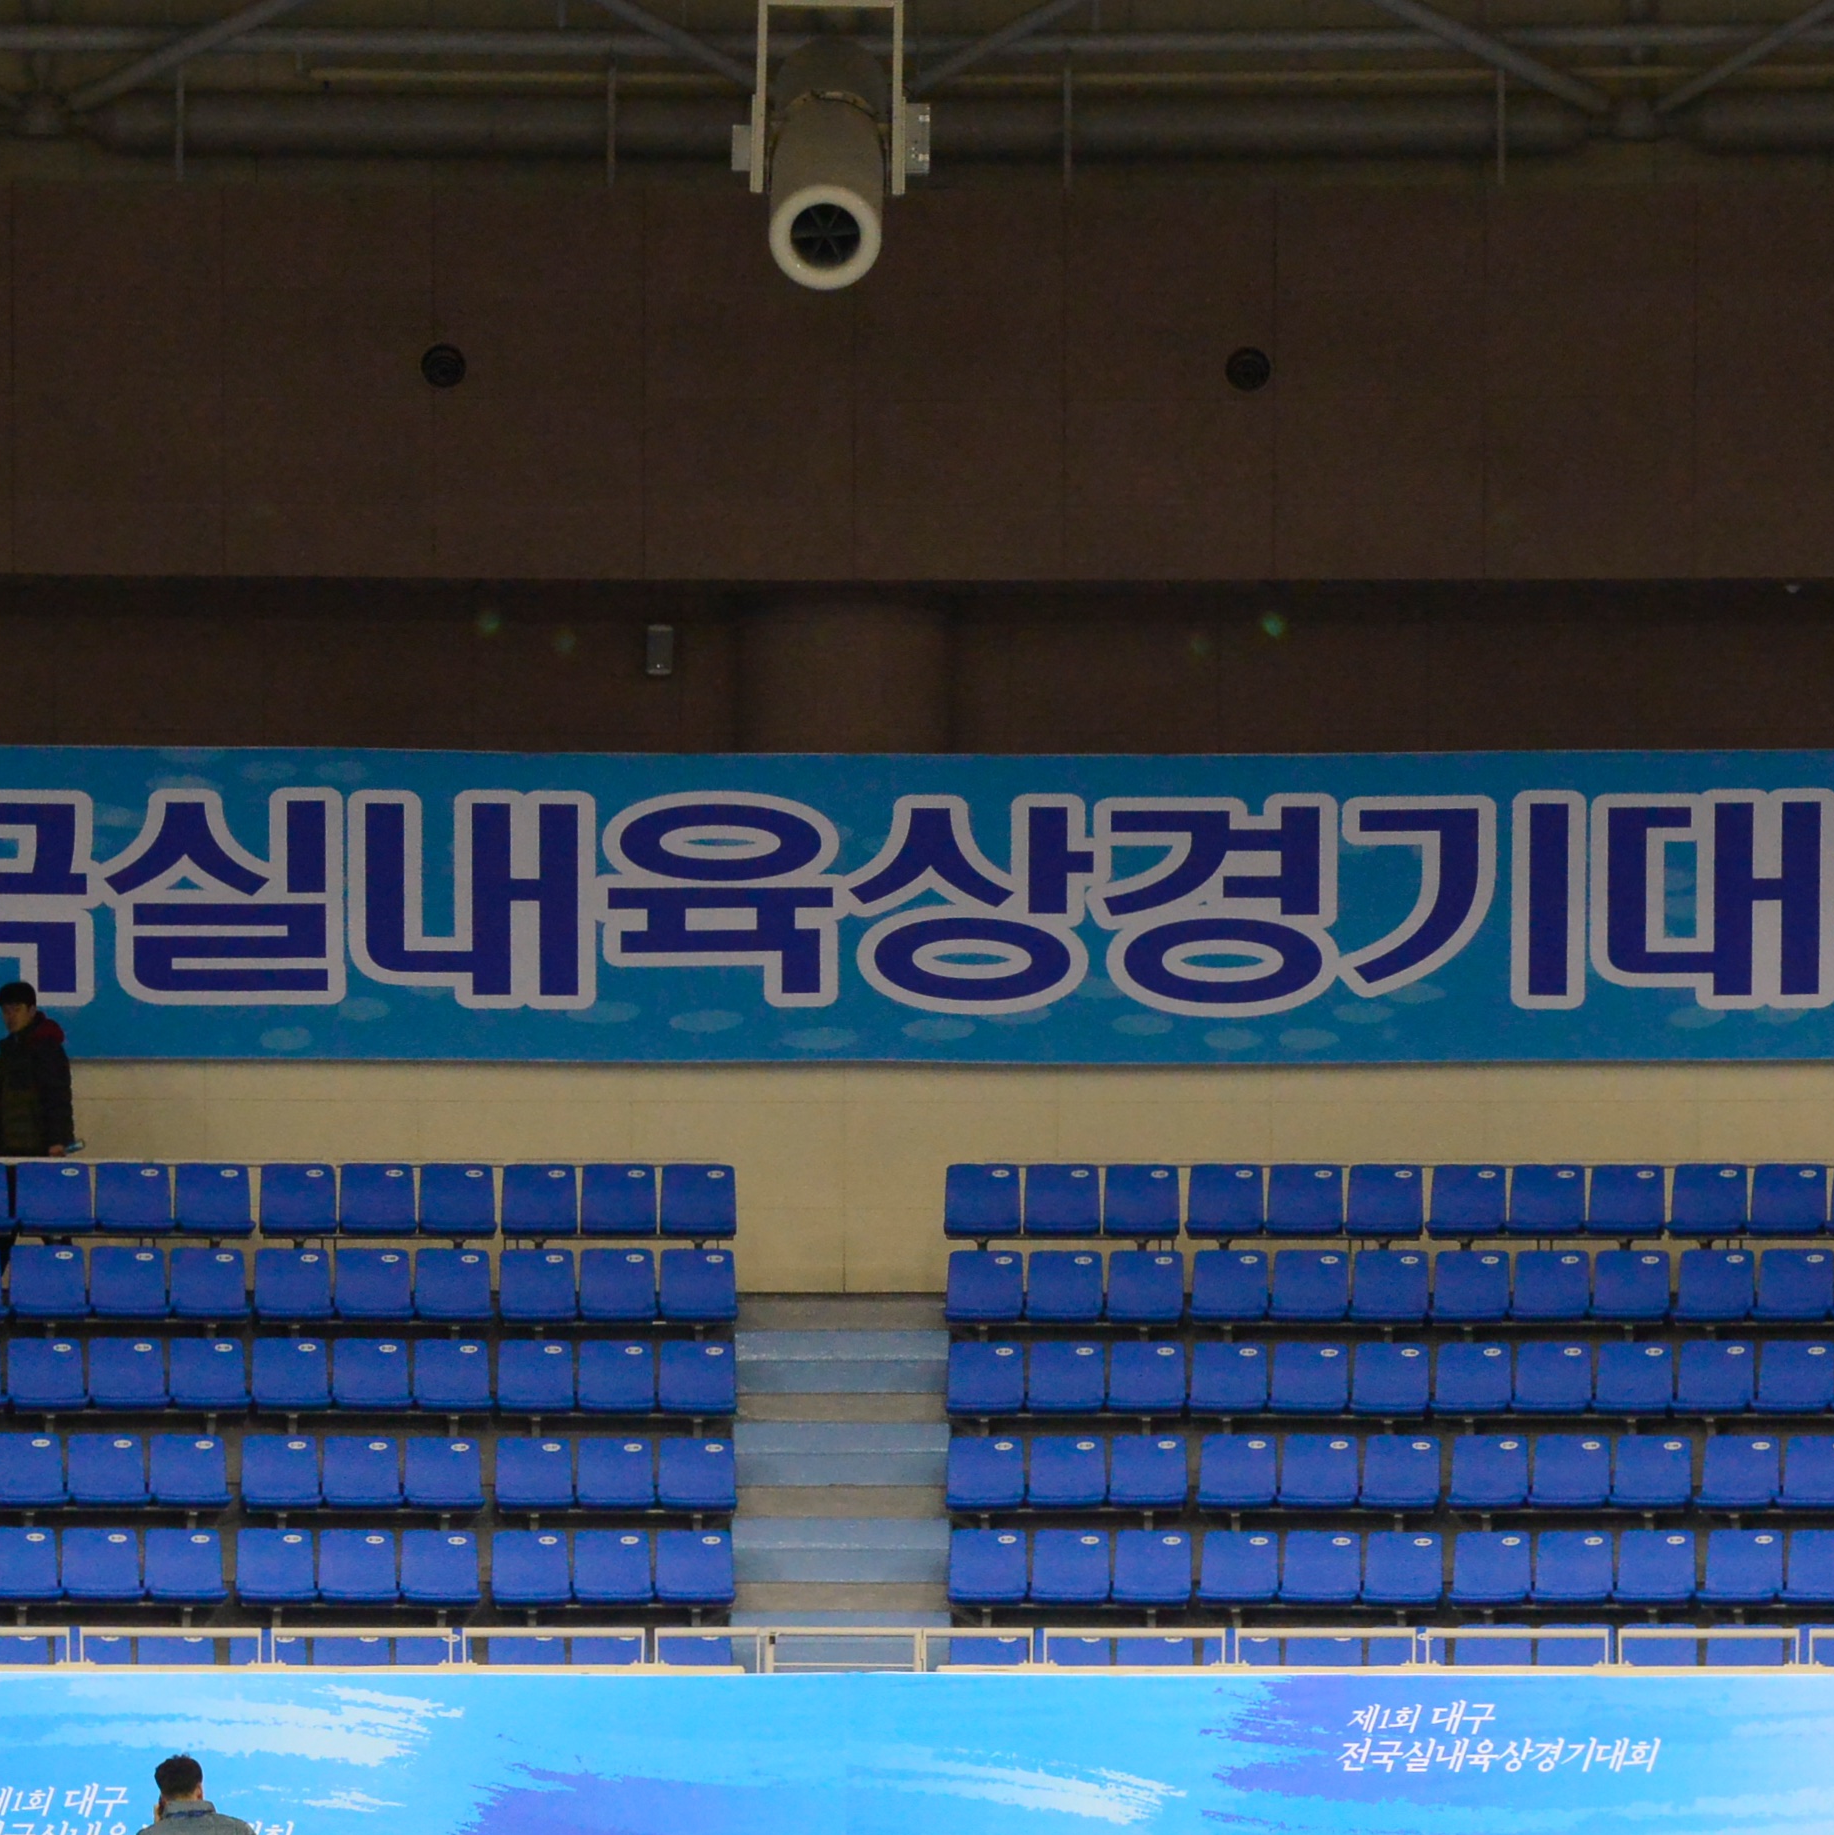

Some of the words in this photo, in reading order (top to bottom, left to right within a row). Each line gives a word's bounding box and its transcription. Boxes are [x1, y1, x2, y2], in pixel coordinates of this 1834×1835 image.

[1347, 1703, 1421, 1733] 제1회
[1432, 1700, 1497, 1735] 대구
[1336, 1737, 1662, 1774] 전국실내육상경기대회
[65, 1782, 129, 1818] 대구
